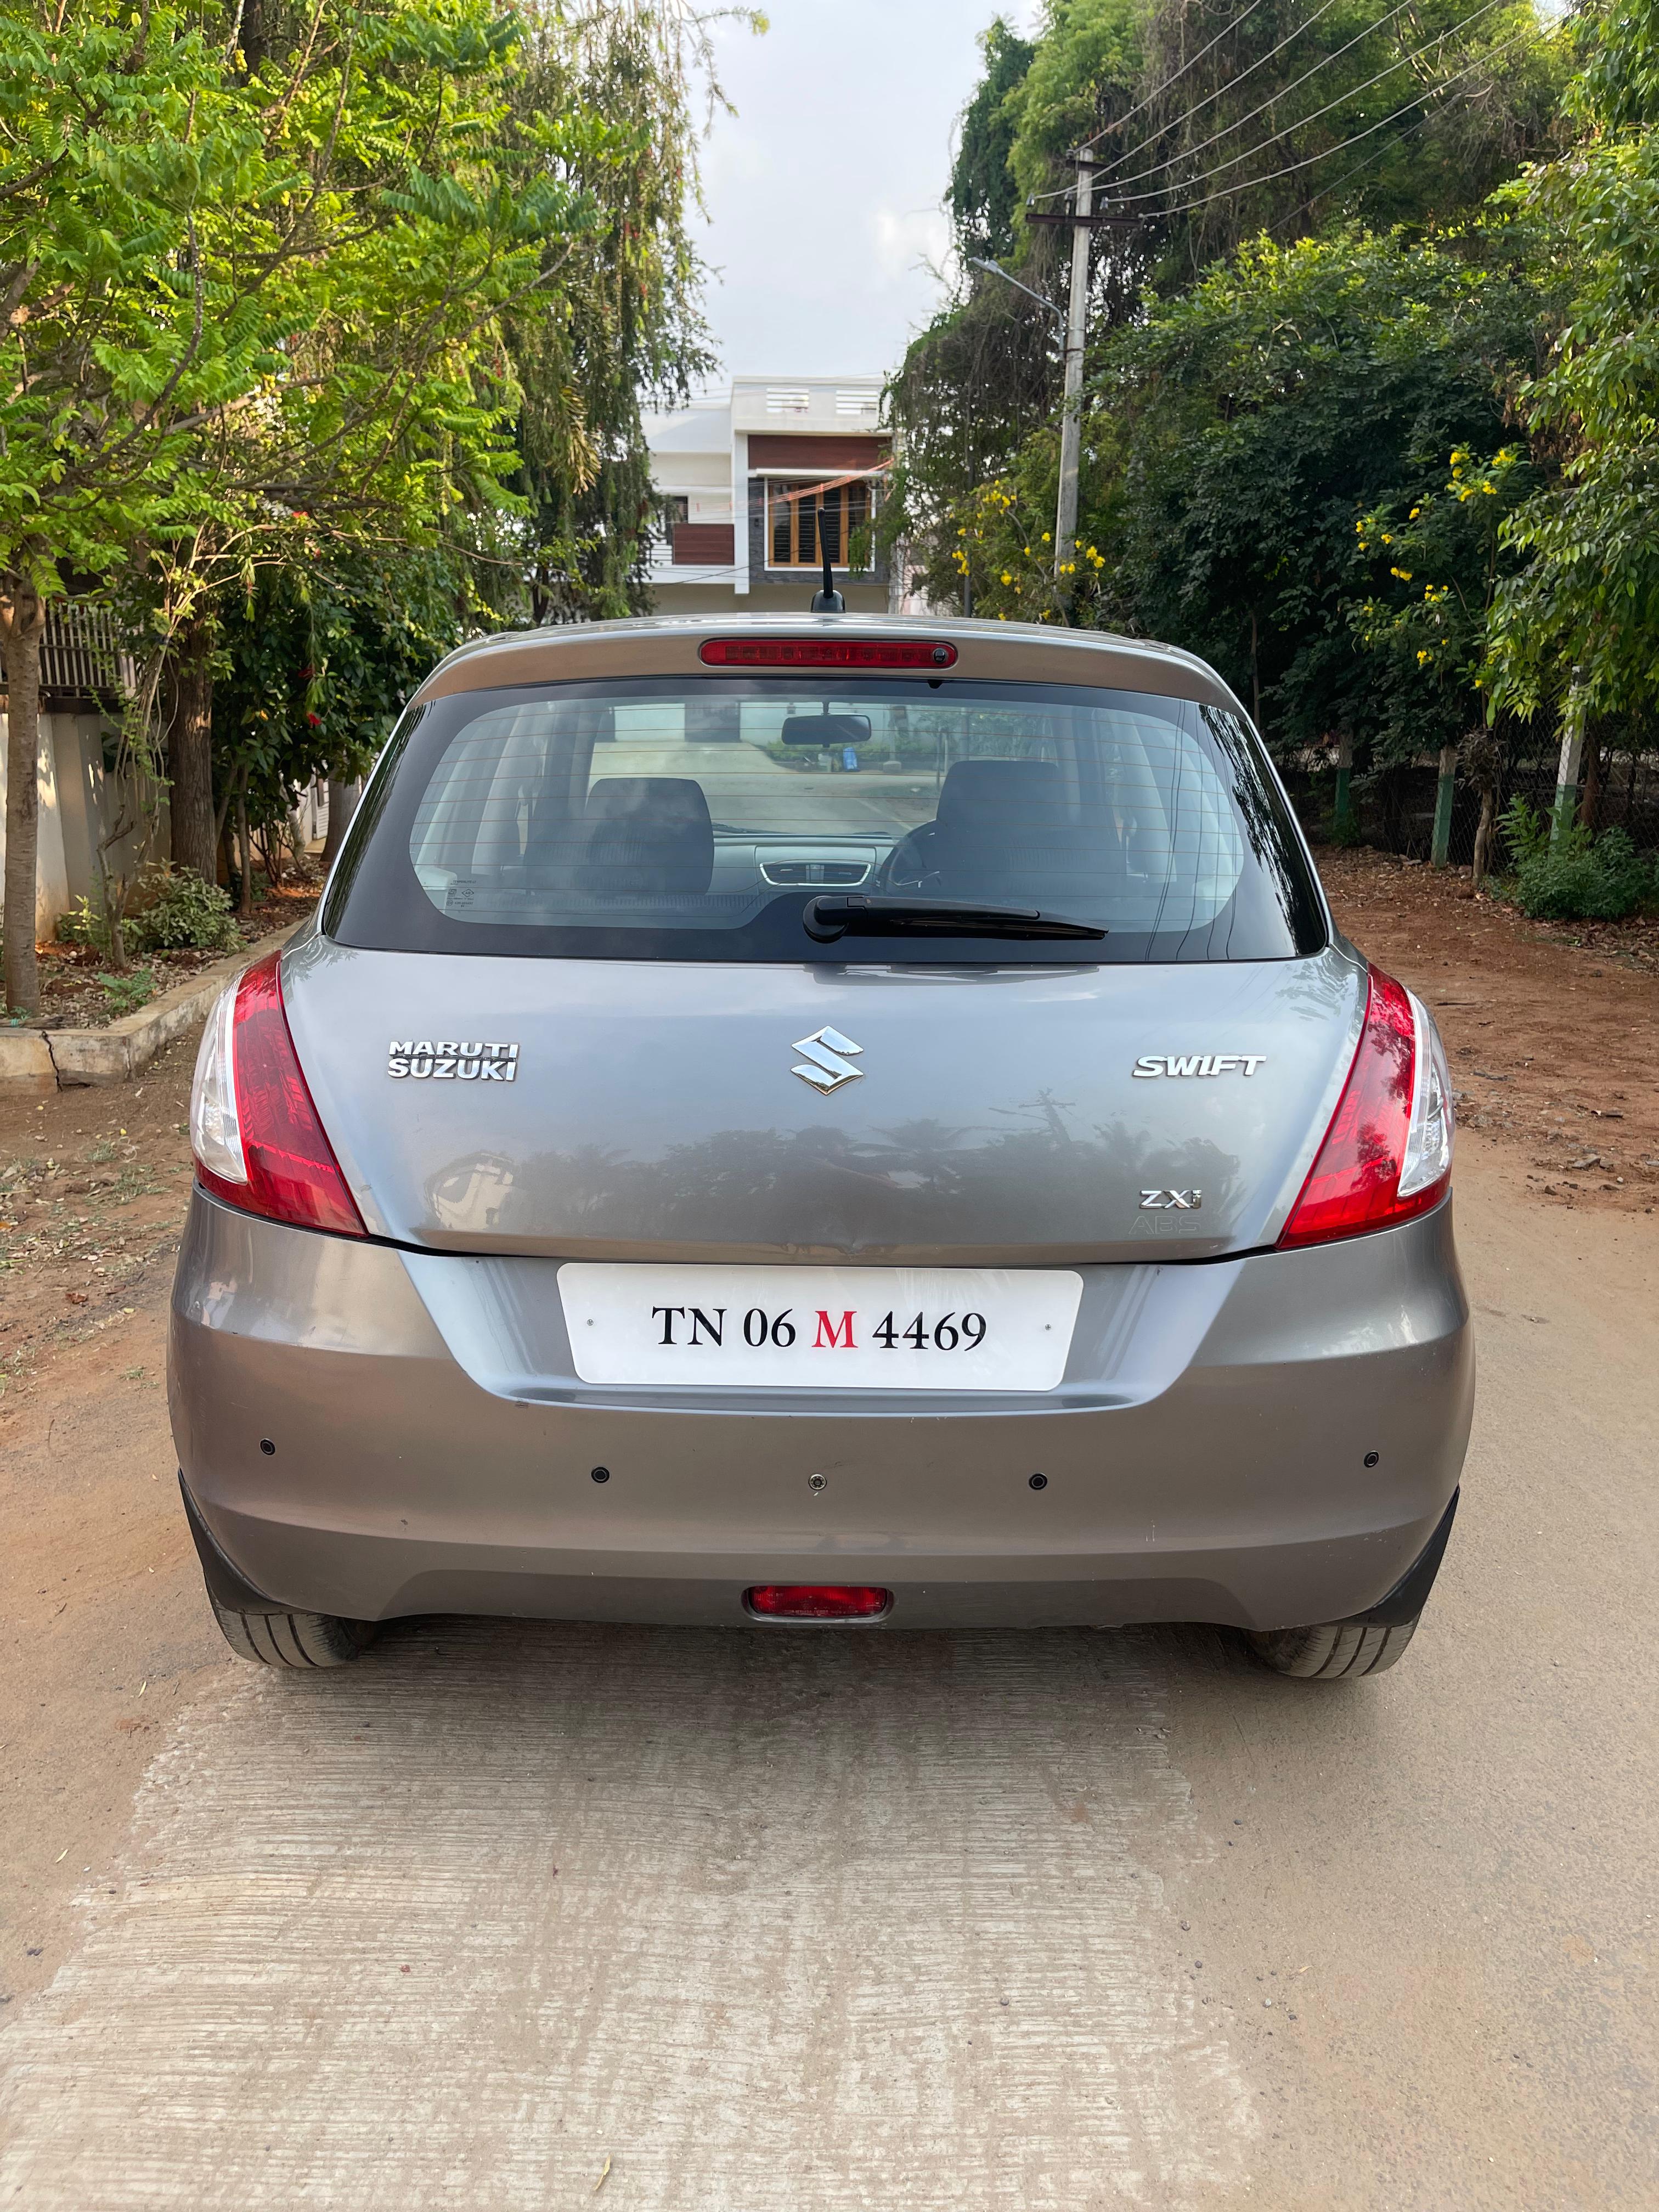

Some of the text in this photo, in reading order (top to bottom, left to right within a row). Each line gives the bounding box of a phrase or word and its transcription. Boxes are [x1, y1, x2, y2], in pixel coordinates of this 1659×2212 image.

[388, 1041, 519, 1058] MARUTI
[387, 1058, 517, 1081] SUZUKI
[1132, 1055, 1267, 1077] SWIFT
[1139, 1189, 1202, 1209] ZXi
[1128, 1215, 1201, 1234] ABS
[652, 1306, 987, 1352] TN 06 M 4469
